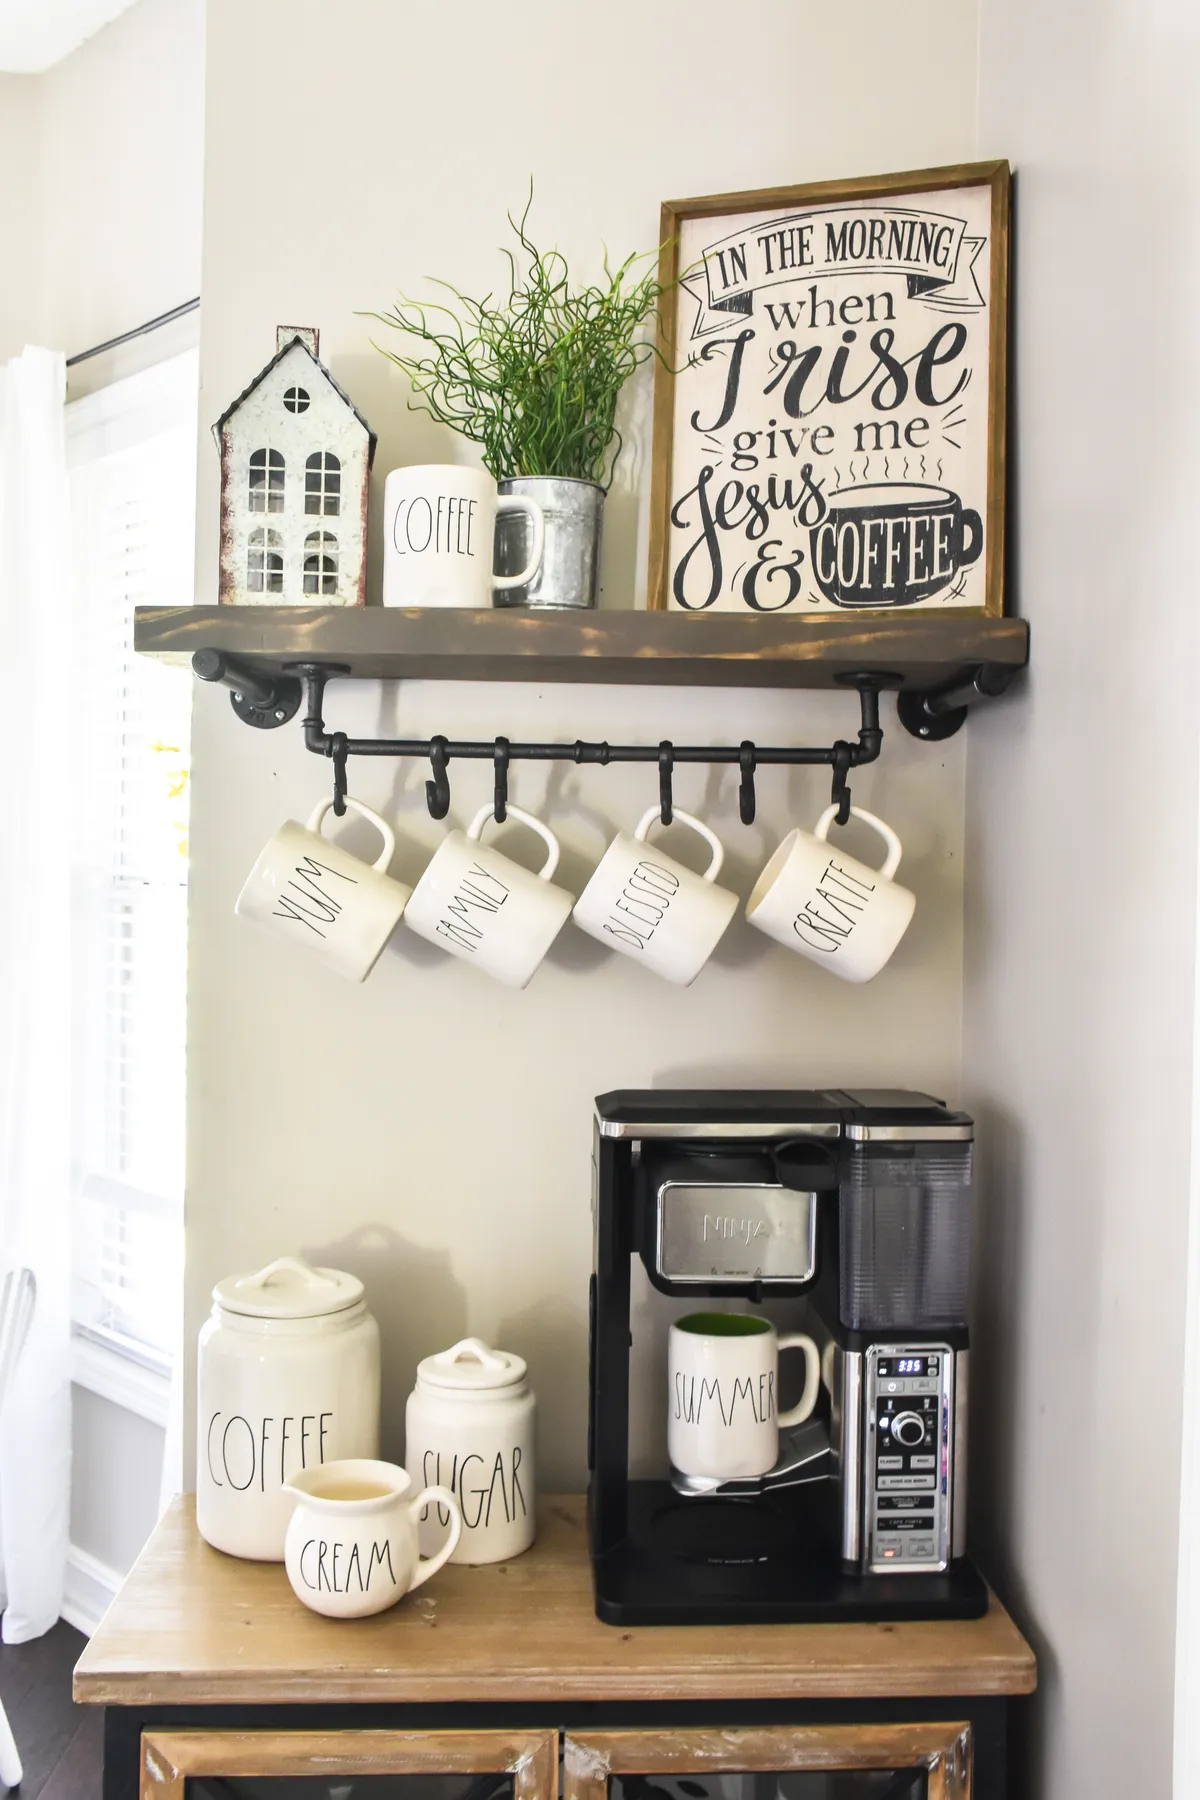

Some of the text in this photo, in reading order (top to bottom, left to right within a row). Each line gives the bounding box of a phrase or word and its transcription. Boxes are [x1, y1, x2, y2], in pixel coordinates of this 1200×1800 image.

[715, 218, 955, 290] IN THE MORNING
[763, 285, 897, 331] when
[690, 322, 968, 433] I rise
[730, 416, 931, 472] give me
[393, 495, 479, 557] COFFEE
[670, 462, 828, 611] Jesus
[742, 512, 956, 612] & COFFEE
[272, 856, 359, 939] YUM
[435, 861, 511, 953] FAMILY
[602, 860, 681, 951] BLESSED
[793, 859, 876, 953] CREATE
[703, 1213, 771, 1247] NINJA
[674, 1370, 776, 1427] SUMMER
[419, 1446, 527, 1529] SUGAR
[300, 1539, 397, 1593] CREAM
